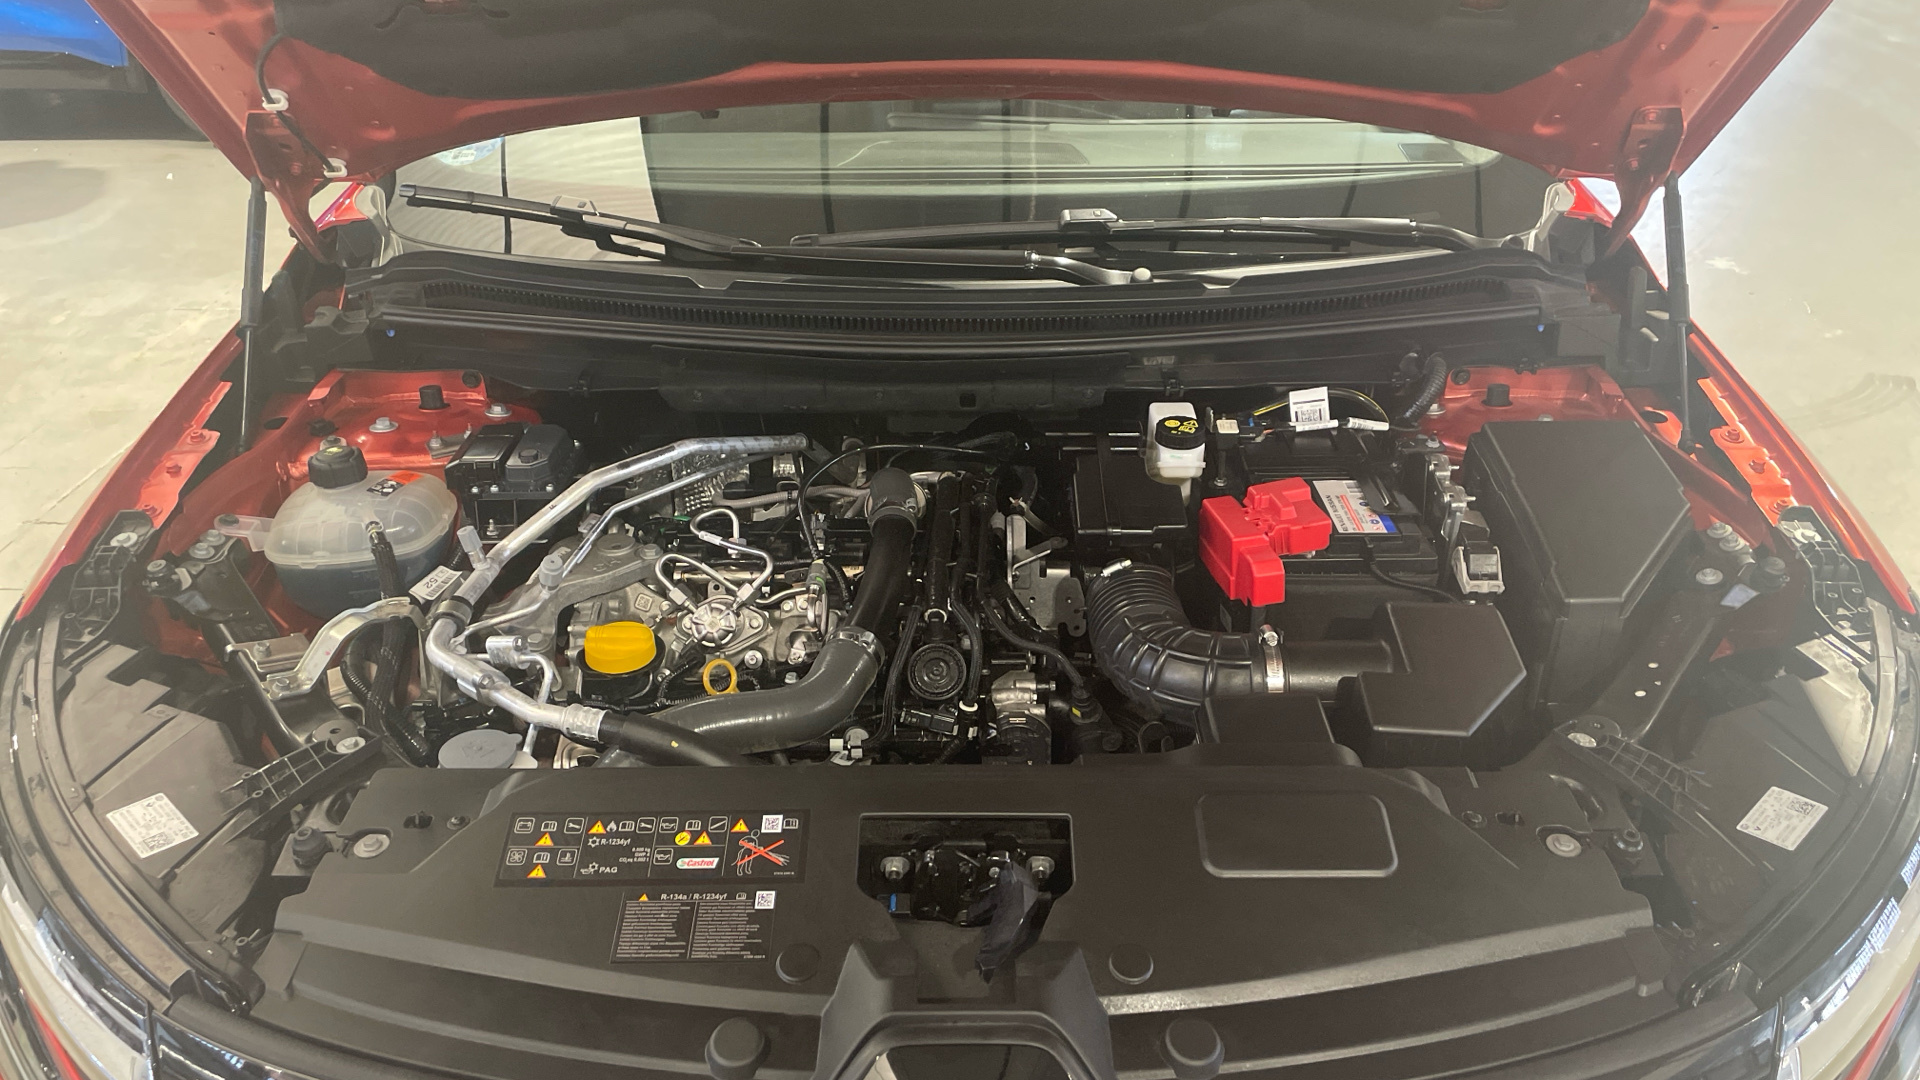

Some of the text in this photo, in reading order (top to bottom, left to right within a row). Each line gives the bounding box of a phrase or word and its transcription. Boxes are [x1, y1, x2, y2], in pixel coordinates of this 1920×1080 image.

[424, 577, 438, 589] 52
[600, 838, 631, 847] R-1234yf
[686, 859, 715, 867] Castrol
[599, 866, 618, 874] PAG
[660, 893, 688, 901] R-134a
[692, 893, 728, 901] R-1234yf
